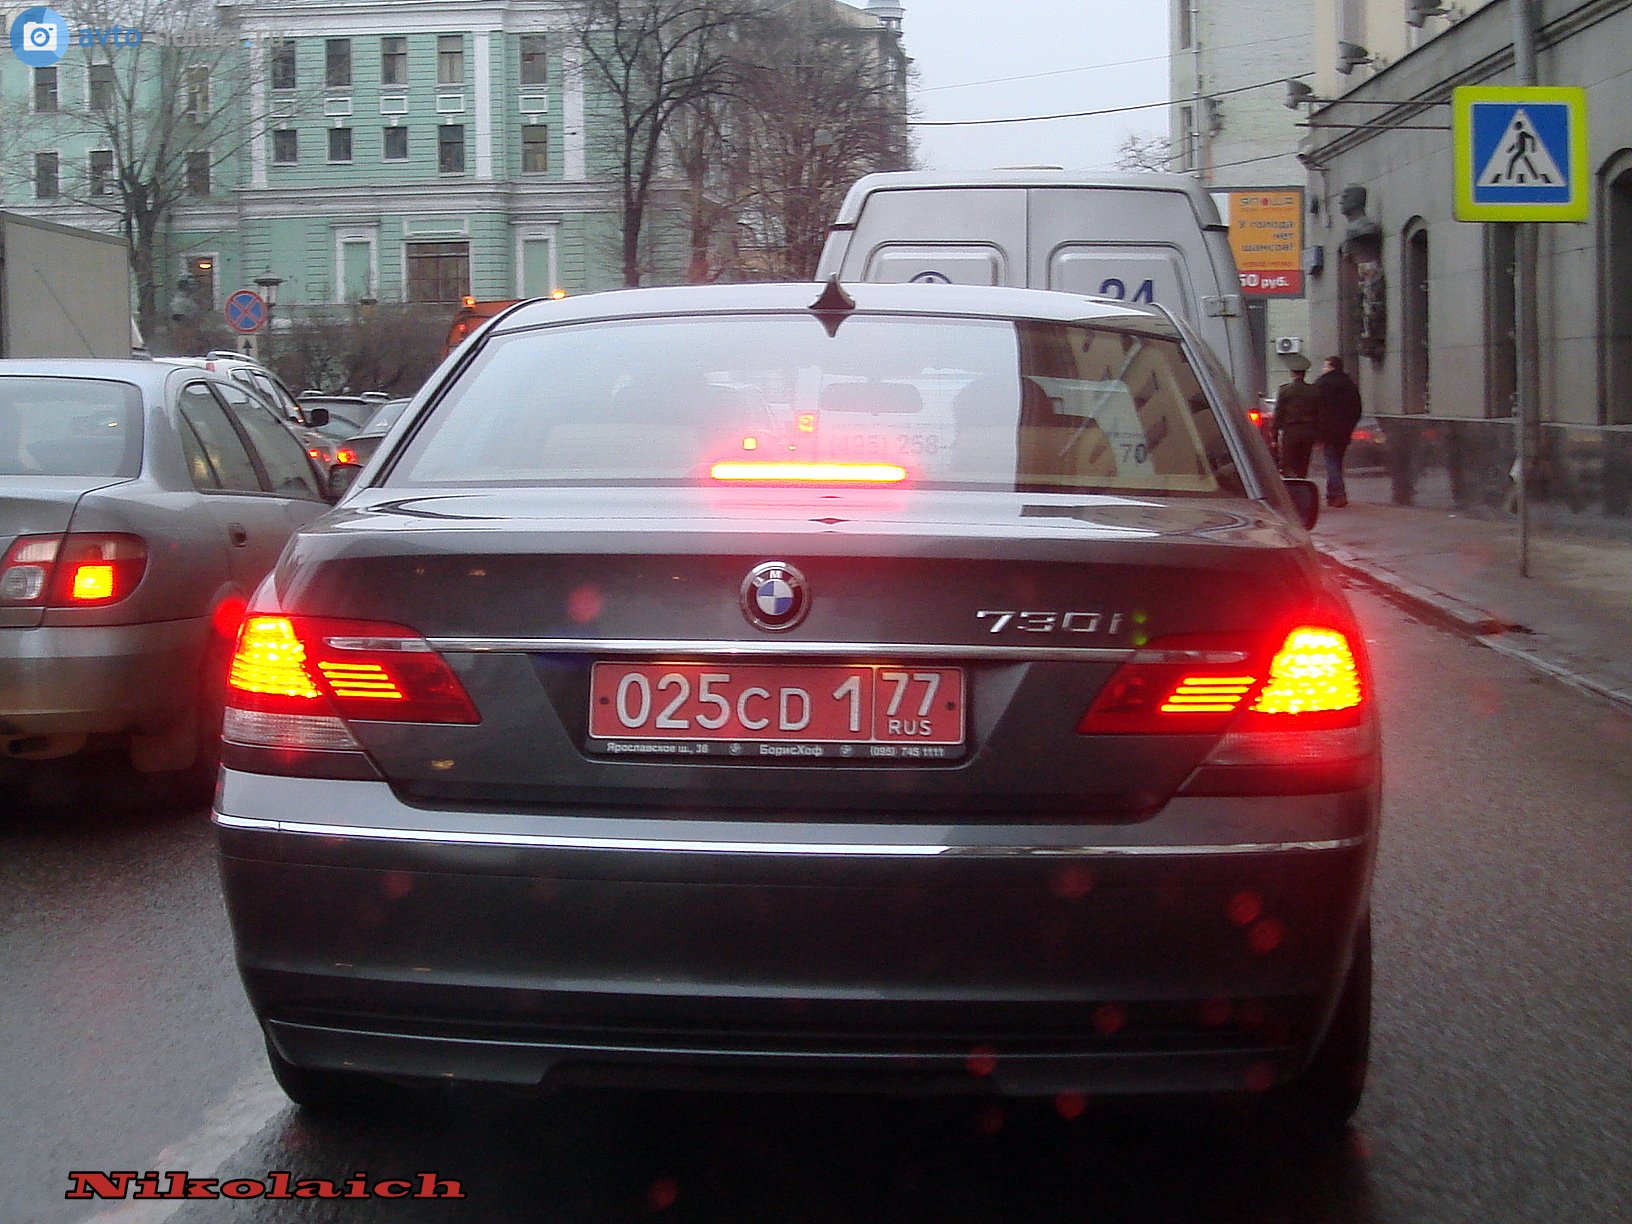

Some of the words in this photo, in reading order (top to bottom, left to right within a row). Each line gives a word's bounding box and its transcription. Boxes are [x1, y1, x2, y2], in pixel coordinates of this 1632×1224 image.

[1261, 276, 1291, 290] руб.
[976, 610, 1124, 635] 730i
[881, 671, 940, 717] 77
[887, 718, 933, 737] RUS
[606, 742, 676, 754] Ярославское
[759, 743, 823, 757] БорисХоф
